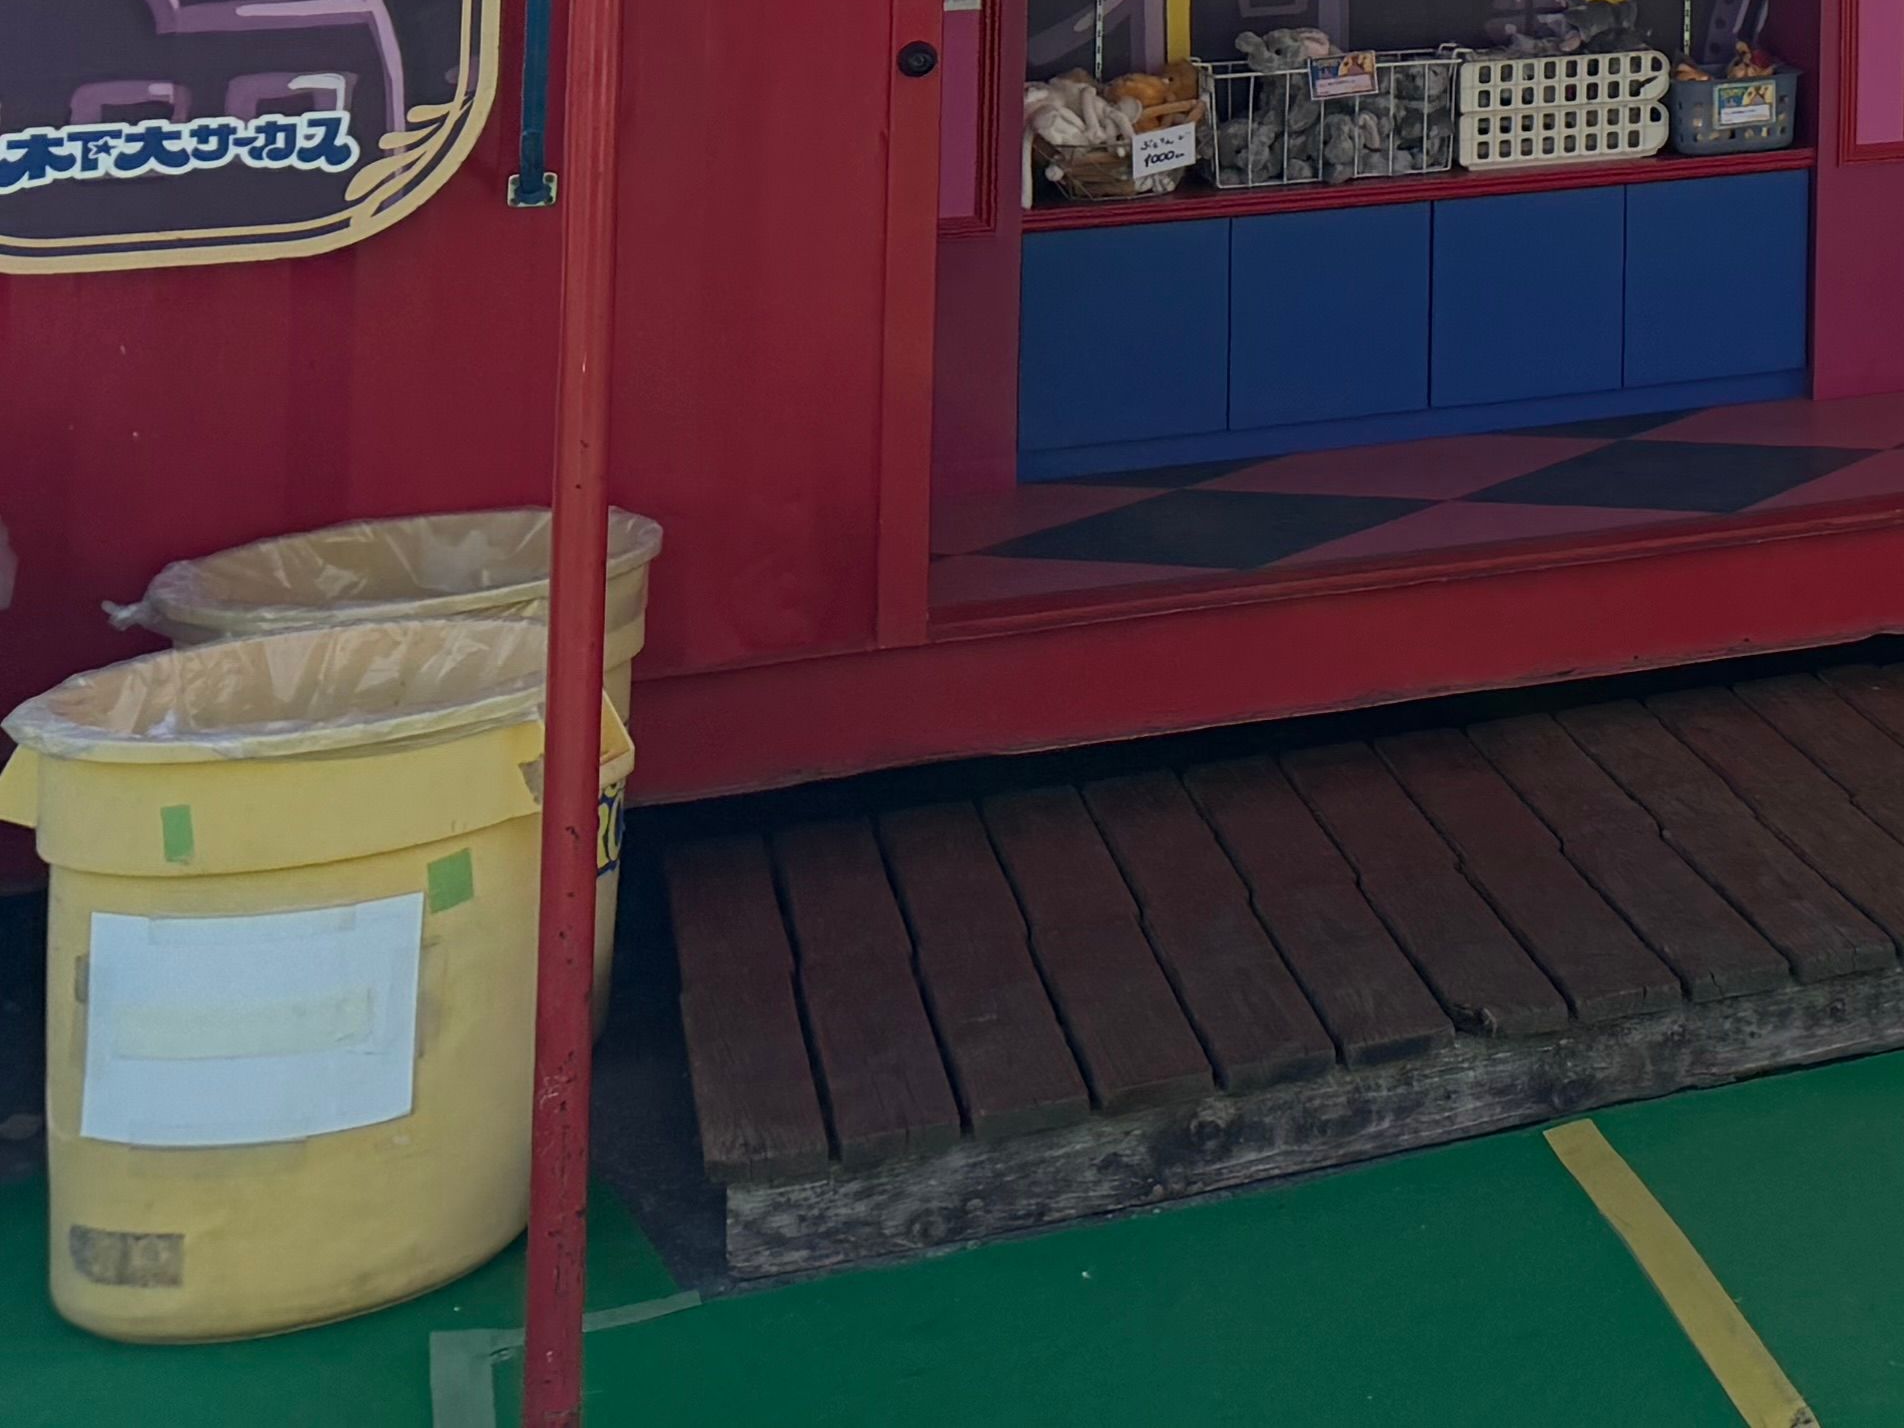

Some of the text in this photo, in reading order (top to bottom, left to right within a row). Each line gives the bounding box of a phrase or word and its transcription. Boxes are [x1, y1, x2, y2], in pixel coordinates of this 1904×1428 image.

[0, 117, 351, 188] 木下大サーカス
